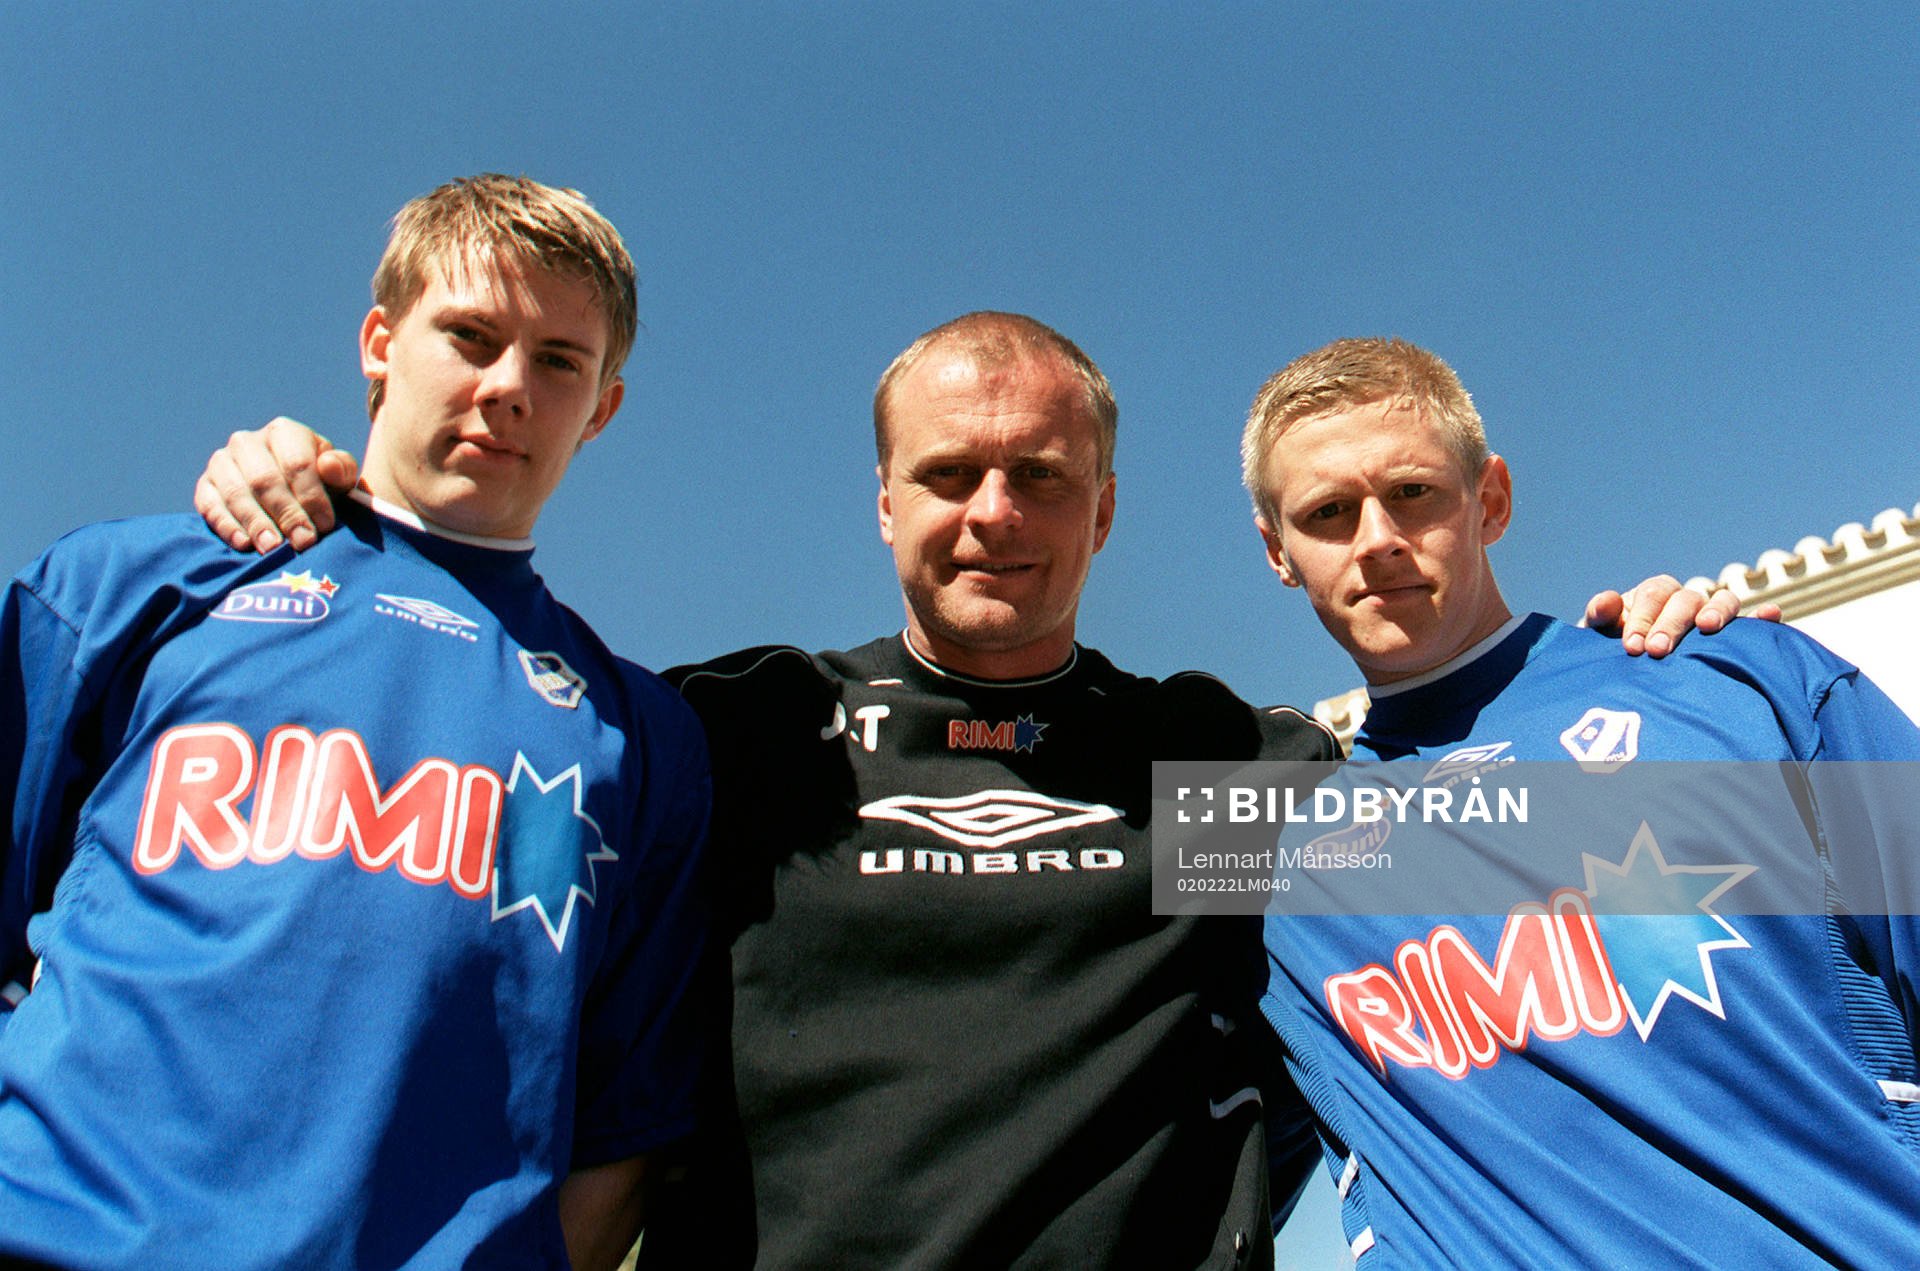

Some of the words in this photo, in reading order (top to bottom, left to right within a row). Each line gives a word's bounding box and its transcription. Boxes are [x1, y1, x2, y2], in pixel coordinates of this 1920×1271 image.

[223, 593, 314, 616] Duni
[949, 720, 1016, 749] RIMI
[132, 722, 504, 899] RIMI
[1324, 887, 1628, 1080] RIMI
